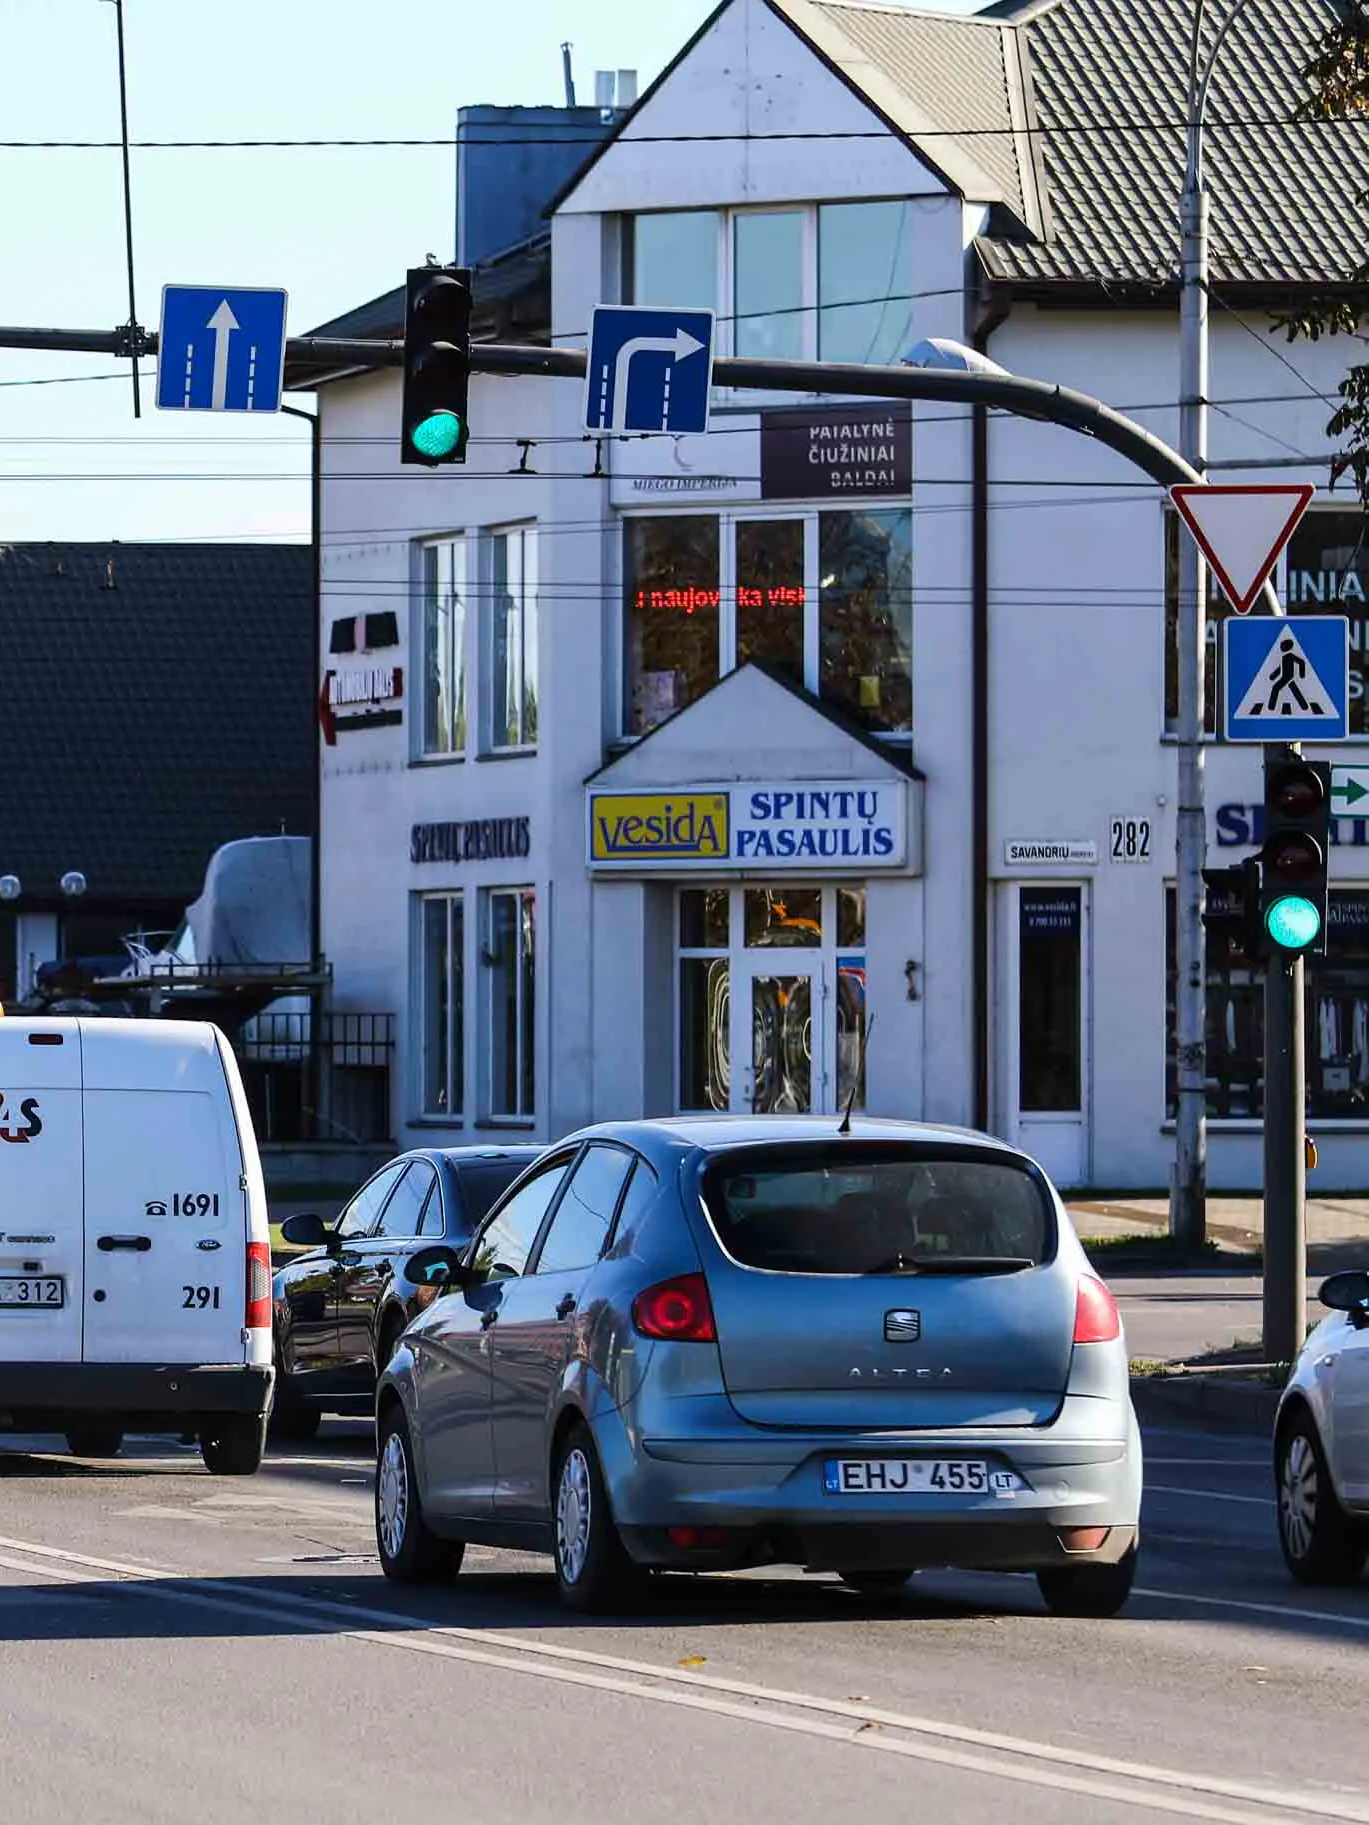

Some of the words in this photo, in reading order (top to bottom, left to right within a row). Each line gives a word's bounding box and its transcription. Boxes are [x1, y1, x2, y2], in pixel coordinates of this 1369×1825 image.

[810, 418, 895, 439] PATALYNĖ
[808, 442, 895, 464] ČIUŽINIAI
[750, 791, 879, 824] SPINTŲ
[735, 827, 894, 858] PASAULIS
[1112, 821, 1150, 857] 282
[173, 1193, 219, 1216] 1691
[18, 1281, 58, 1301] 312
[182, 1285, 220, 1308] 291
[849, 1367, 952, 1378] ALTEA
[843, 1463, 908, 1489] EHJ
[930, 1463, 983, 1489] 455
[996, 1474, 1014, 1488] LT
